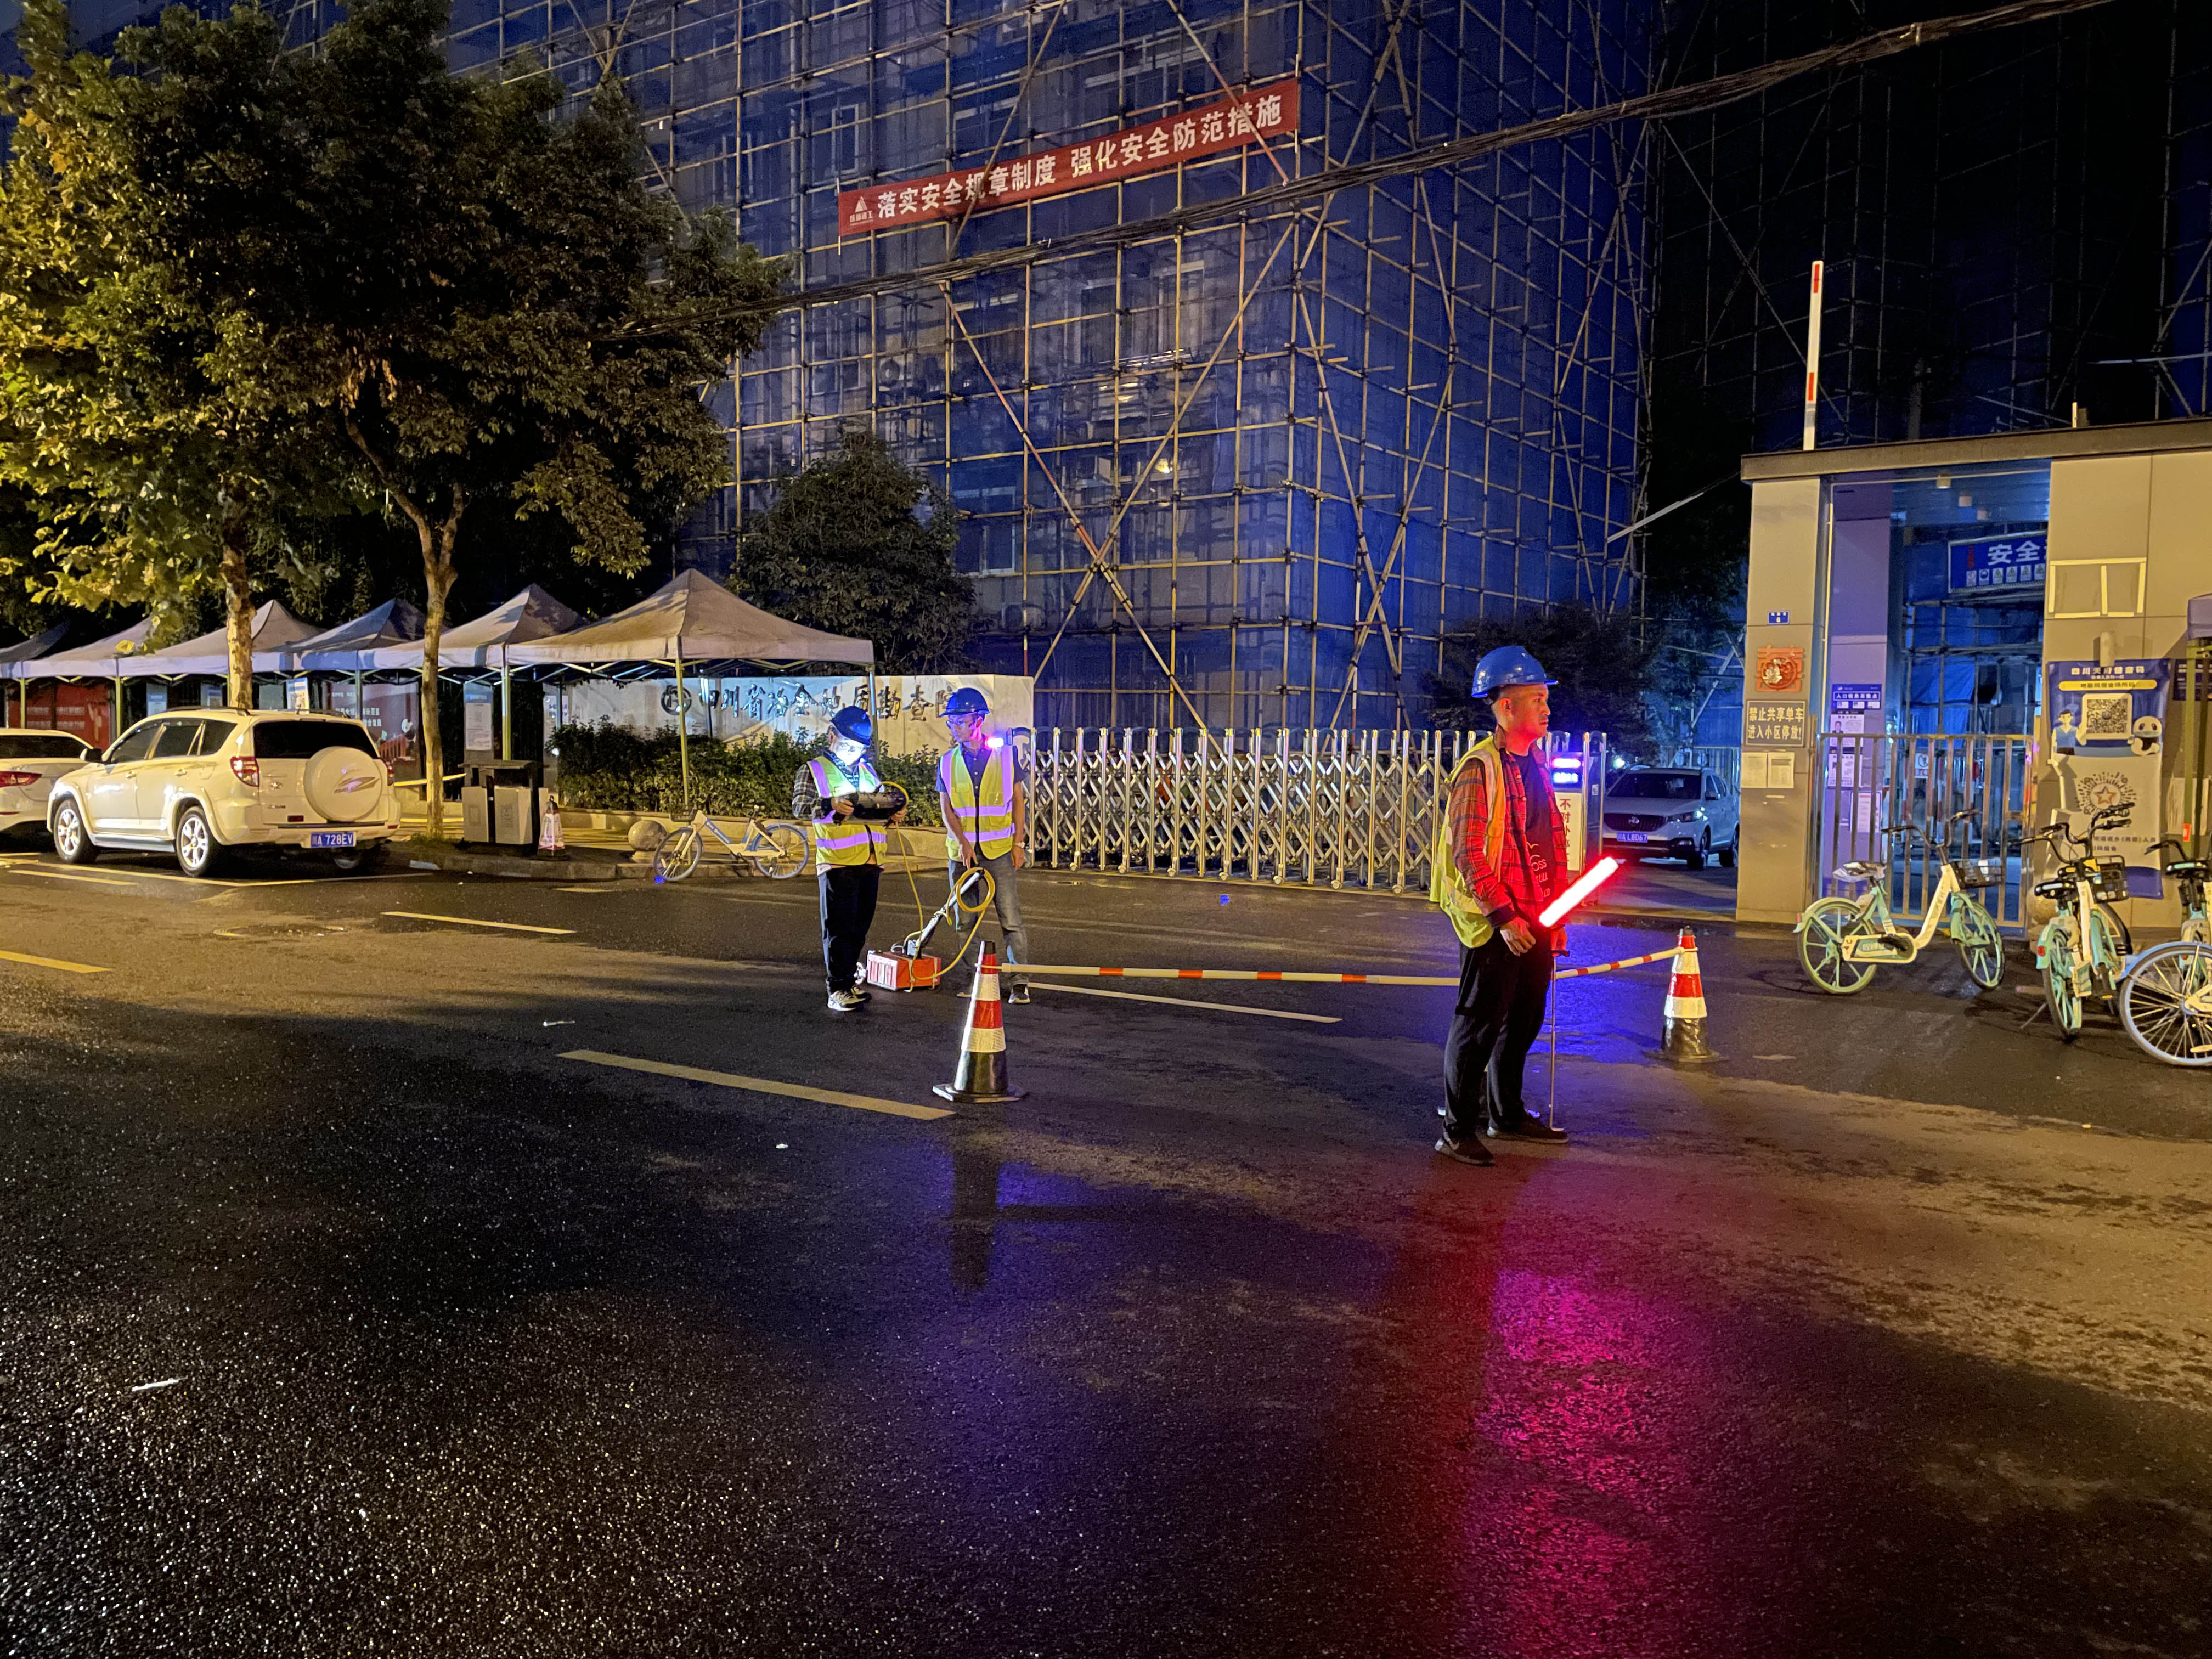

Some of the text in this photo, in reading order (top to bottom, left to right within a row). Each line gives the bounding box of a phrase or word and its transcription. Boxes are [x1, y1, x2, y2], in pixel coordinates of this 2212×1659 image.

[878, 94, 1282, 219] 落实安全规章制度 强化安全防范措施
[1987, 539, 2047, 566] 安全
[1749, 707, 1804, 723] 禁止共享单车
[325, 833, 353, 845] 728EV
